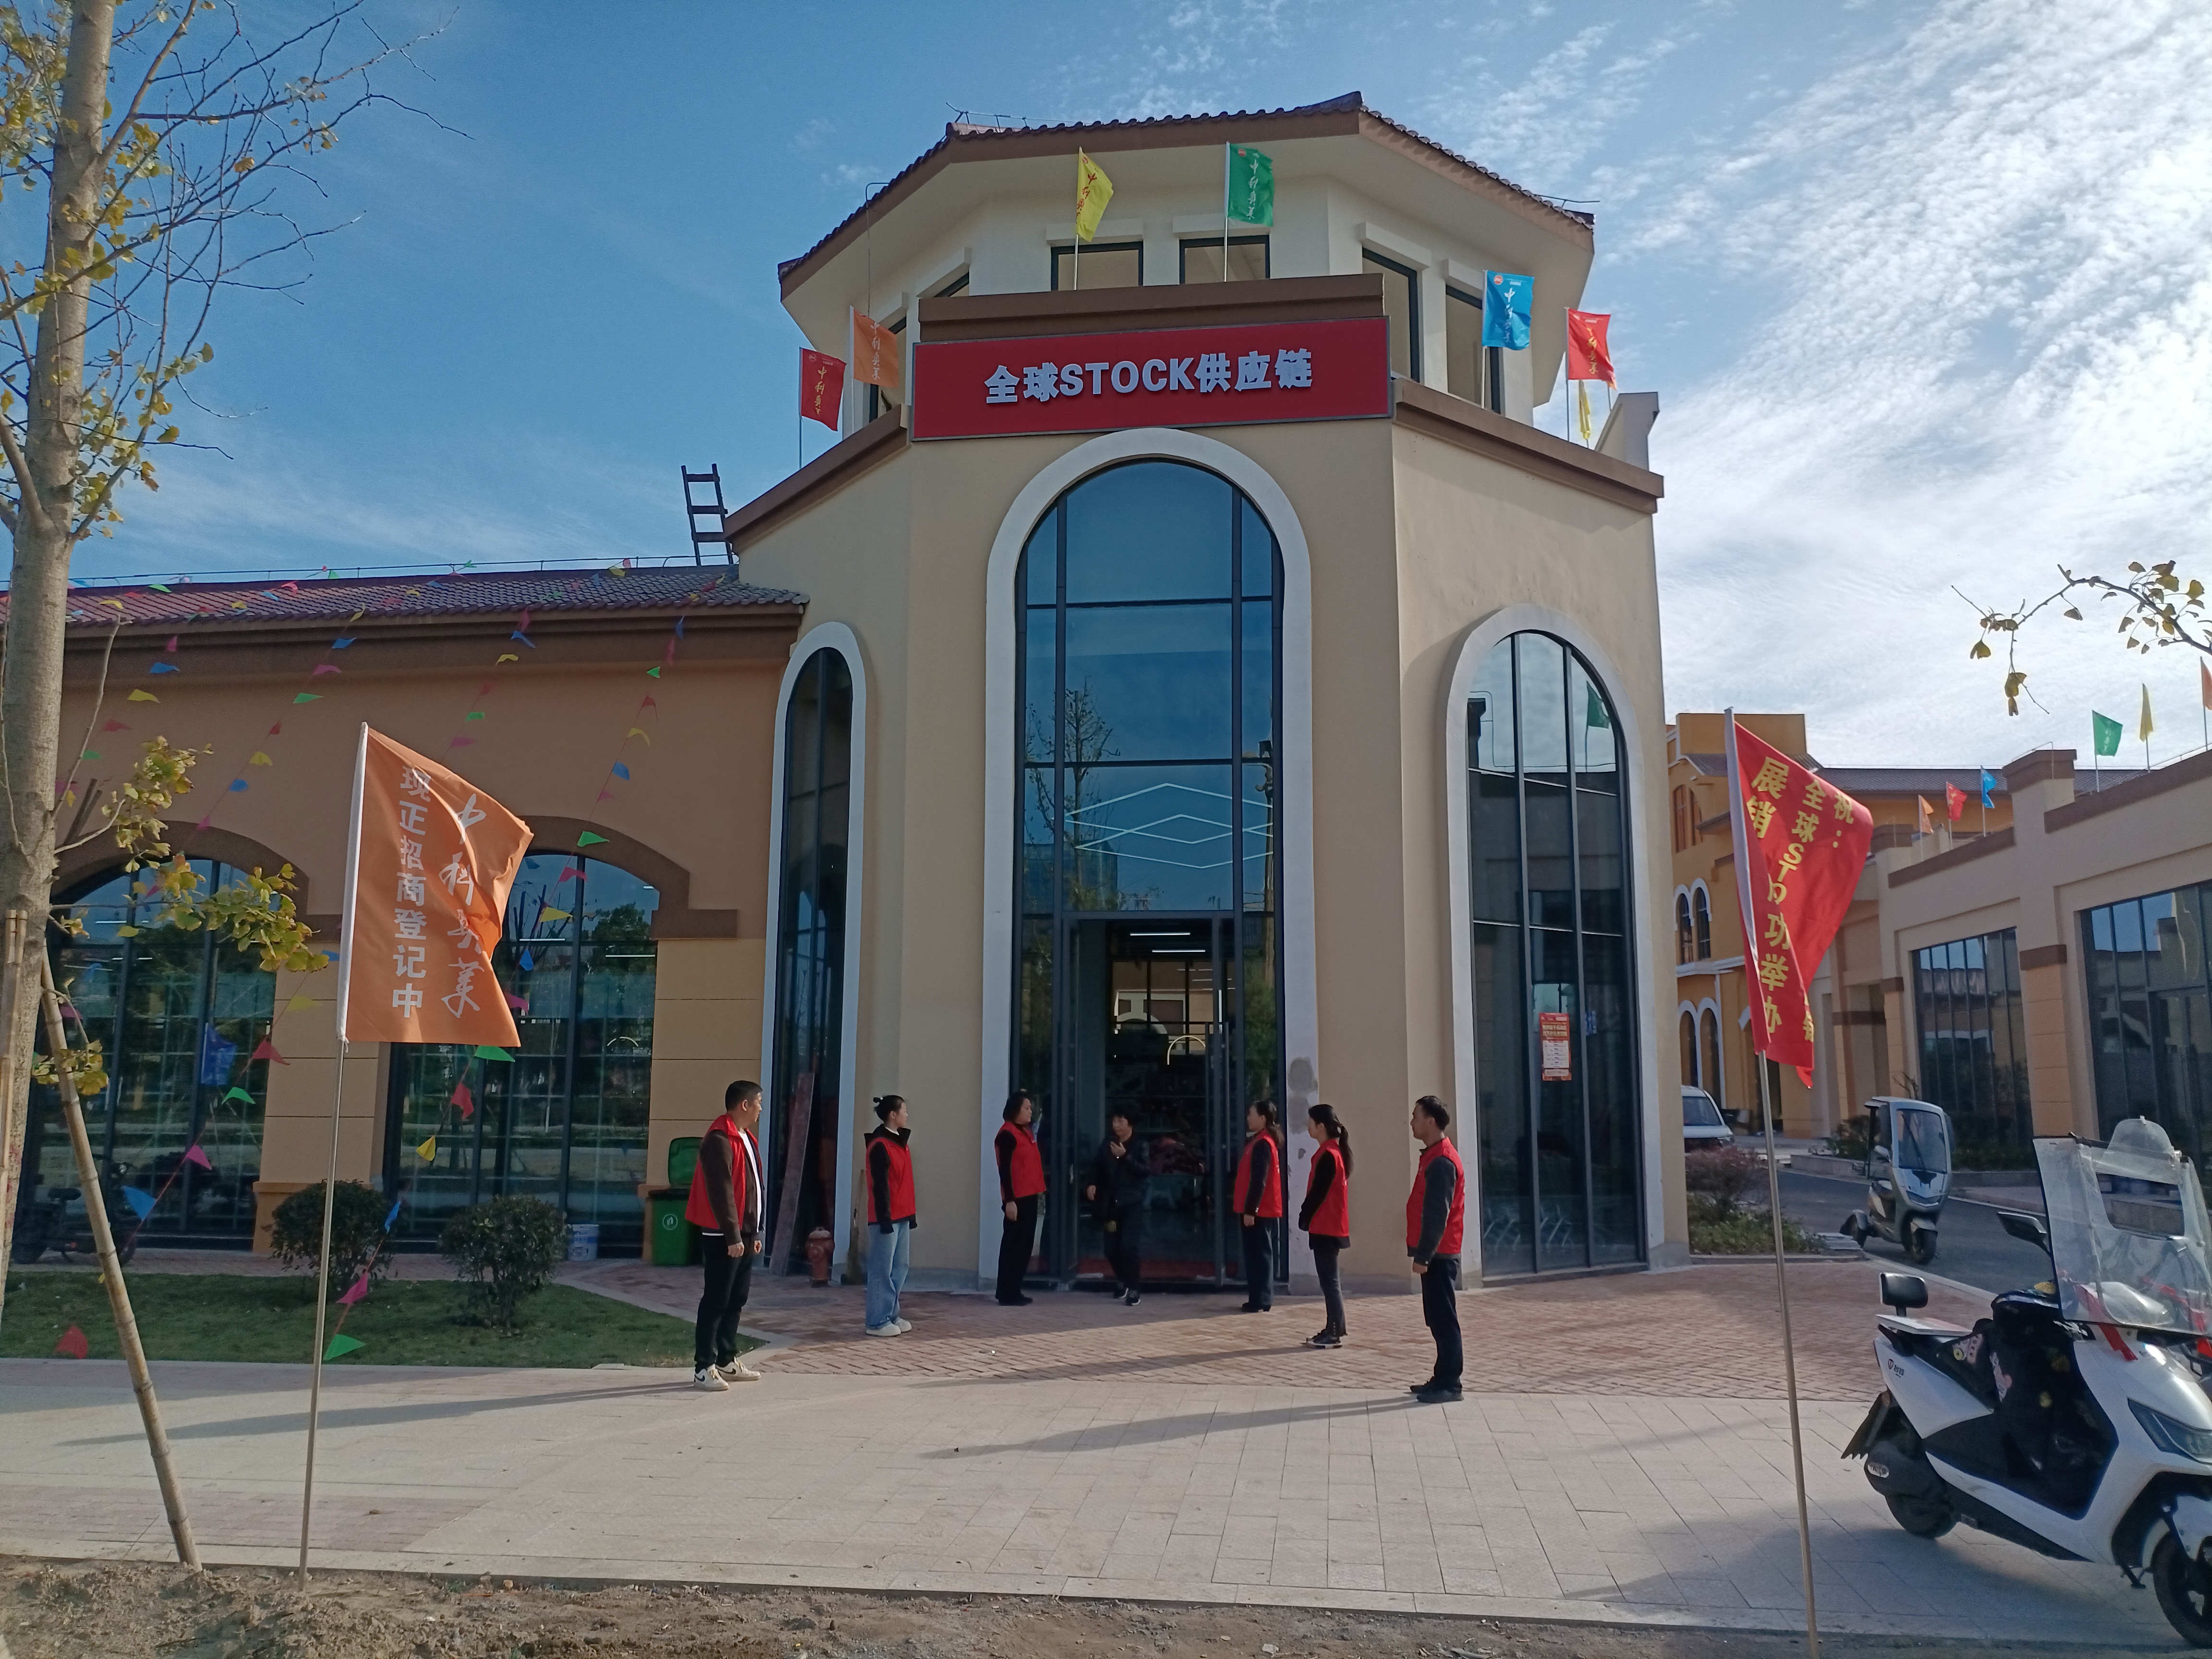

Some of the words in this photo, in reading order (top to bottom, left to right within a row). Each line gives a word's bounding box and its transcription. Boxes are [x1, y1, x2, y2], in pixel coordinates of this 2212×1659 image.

[984, 348, 1312, 403] 全球STOCK供应链
[392, 766, 432, 1018] 现正招商登记中
